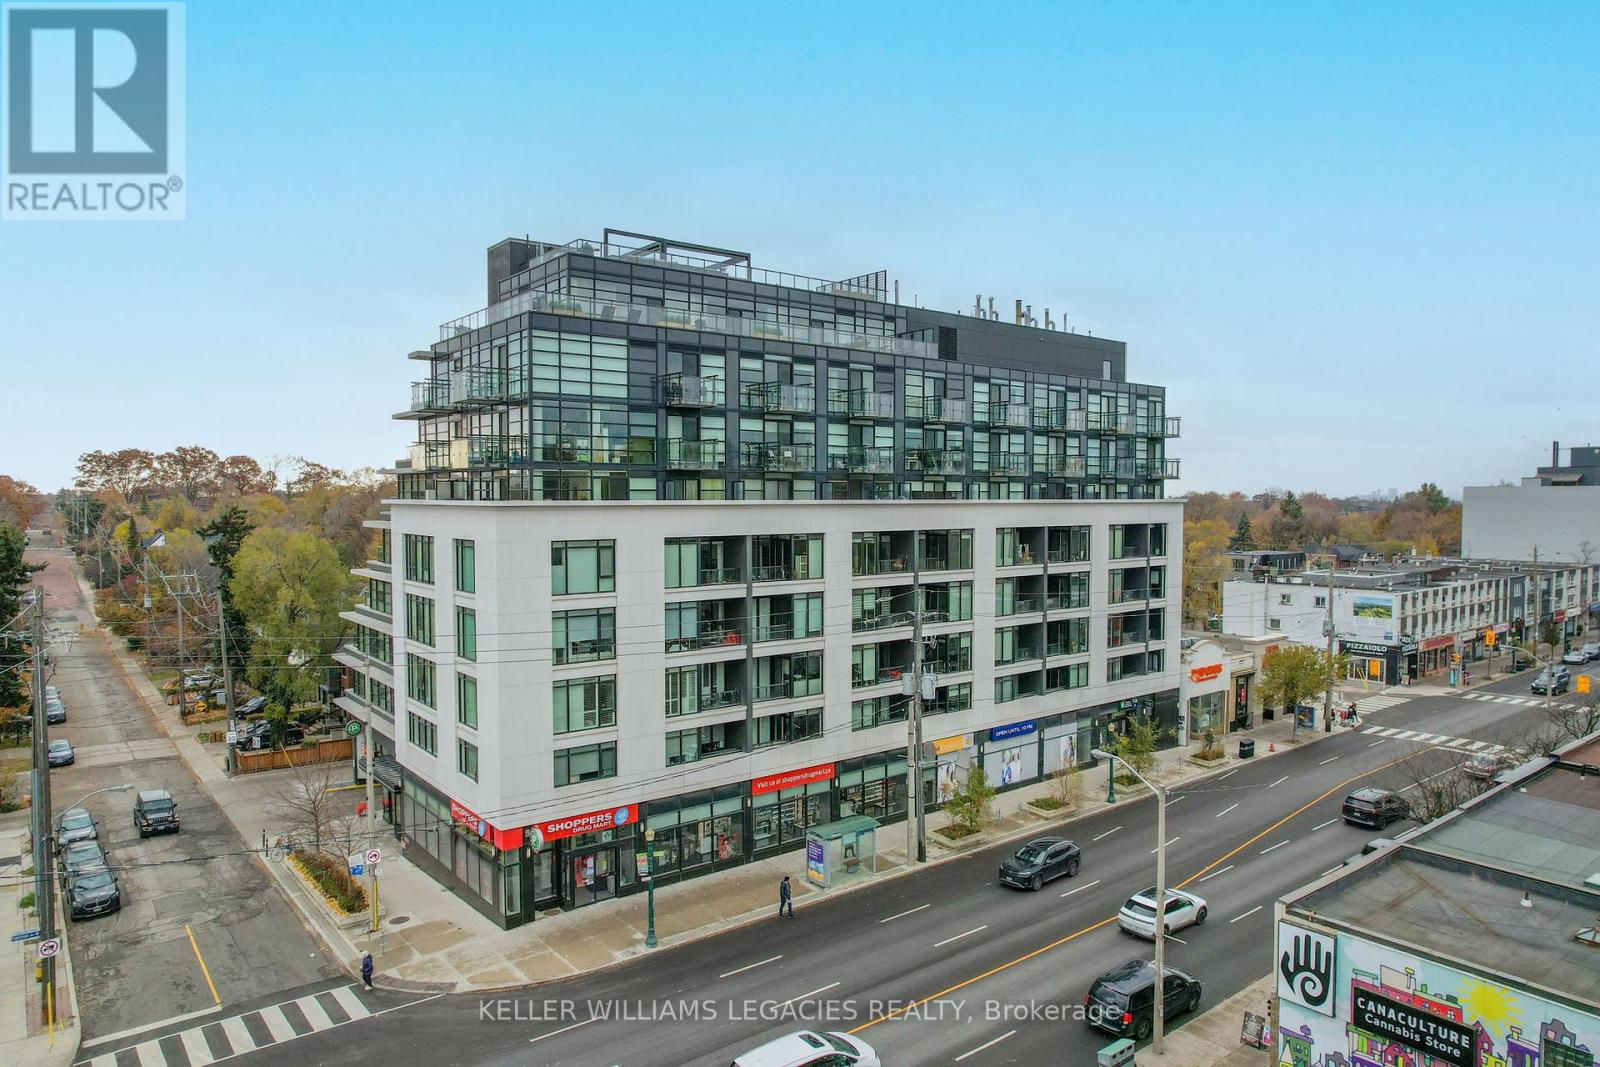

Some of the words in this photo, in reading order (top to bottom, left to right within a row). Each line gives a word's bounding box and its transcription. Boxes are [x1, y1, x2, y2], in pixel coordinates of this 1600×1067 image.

[1346, 642, 1387, 652] PIZZAIOLO
[782, 768, 831, 784] shoppersdrugmart.ca
[547, 812, 612, 833] SHOPPERS
[572, 823, 592, 833] DRUG
[593, 820, 612, 829] MART
[1357, 997, 1470, 1049] CANACULTURE
[1365, 1013, 1421, 1042] Cannabis
[1425, 1035, 1461, 1058] Store
